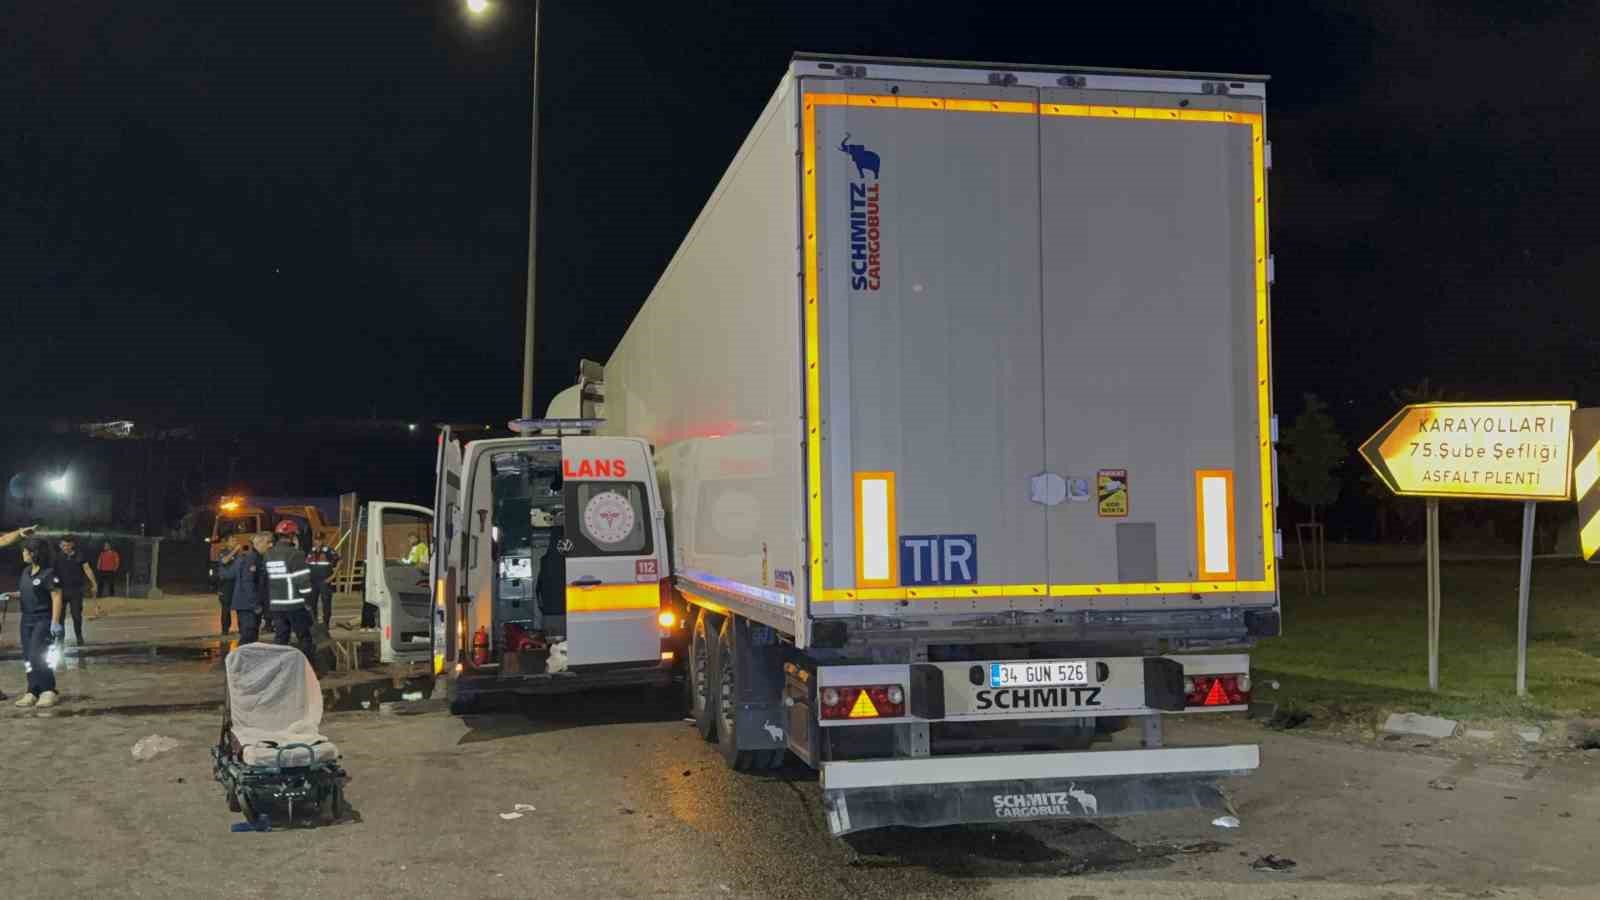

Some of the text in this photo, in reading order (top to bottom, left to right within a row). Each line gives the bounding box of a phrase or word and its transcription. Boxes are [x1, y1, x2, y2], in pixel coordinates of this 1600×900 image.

[850, 182, 867, 290] SCHMITZ
[868, 183, 880, 290] CARGOBULL
[1418, 417, 1555, 433] KARAYOLLARI
[1492, 442, 1558, 463] Şefliği
[563, 459, 627, 478] LANS
[1422, 470, 1480, 484] ASFALT
[639, 562, 656, 573] 112
[904, 539, 972, 582] TIR
[1001, 664, 1084, 684] 34 GUN 526
[976, 687, 1102, 710] SCHMITZ
[993, 792, 1069, 808] SCHMITZ
[995, 804, 1071, 817] CARGOBULL
